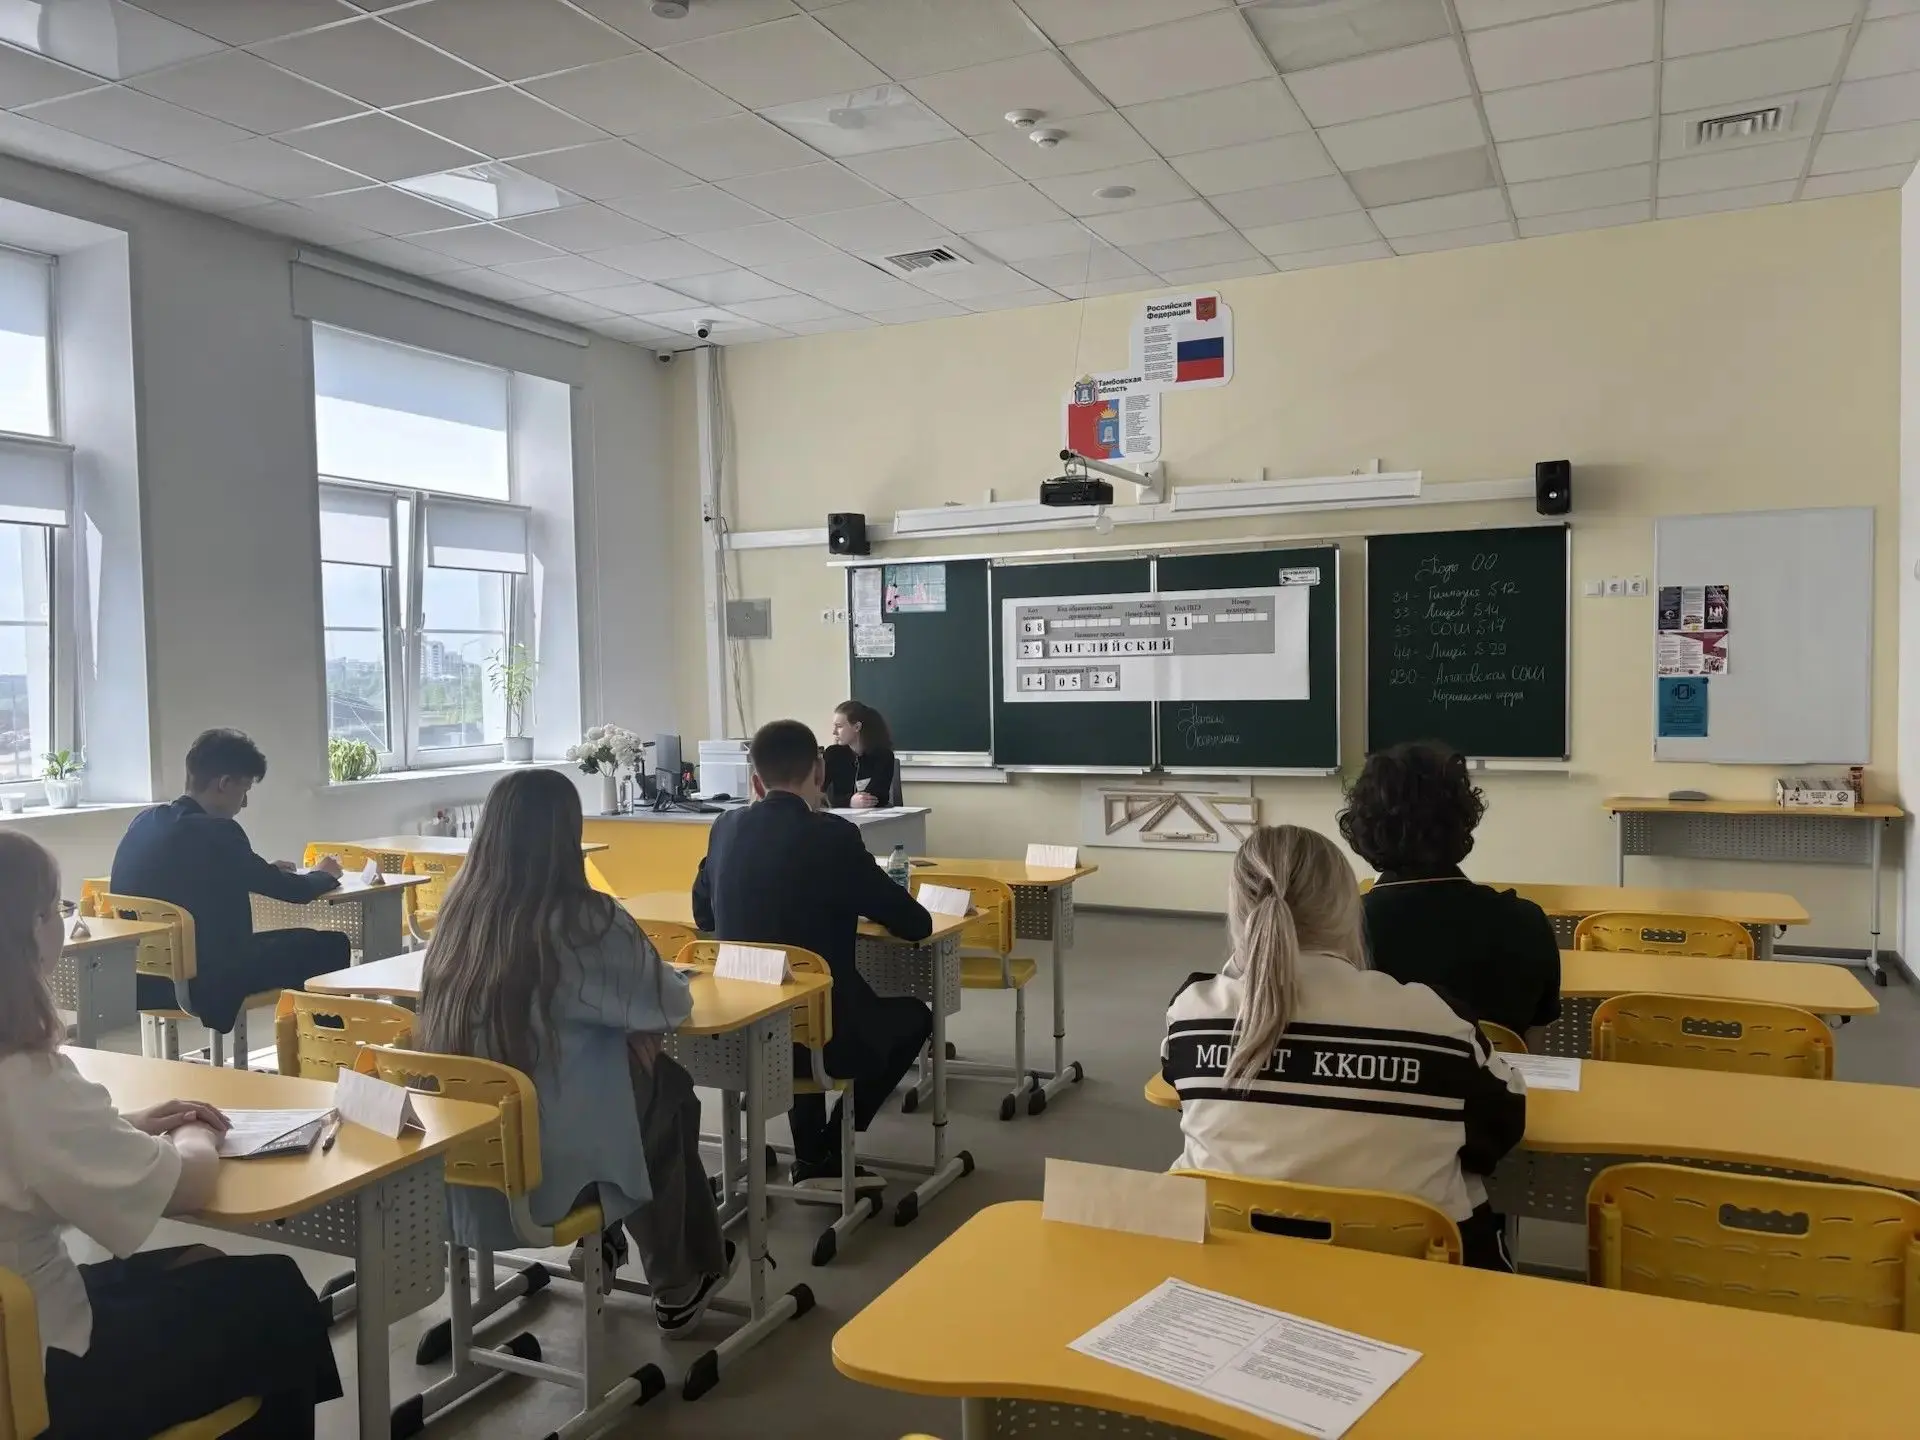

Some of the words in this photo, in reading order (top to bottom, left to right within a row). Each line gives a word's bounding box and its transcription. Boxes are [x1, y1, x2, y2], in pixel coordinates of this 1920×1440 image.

[1147, 301, 1192, 312] Российская
[1147, 309, 1190, 320] Федерация
[1098, 375, 1141, 386] Тамбовская
[1098, 385, 1128, 394] область
[1025, 622, 1042, 632] 68
[1052, 638, 1171, 653] АНГЛИЙСКИЙ
[1026, 677, 1042, 686] 14
[1094, 675, 1112, 684] 26
[1312, 1052, 1422, 1084] KKOUB
